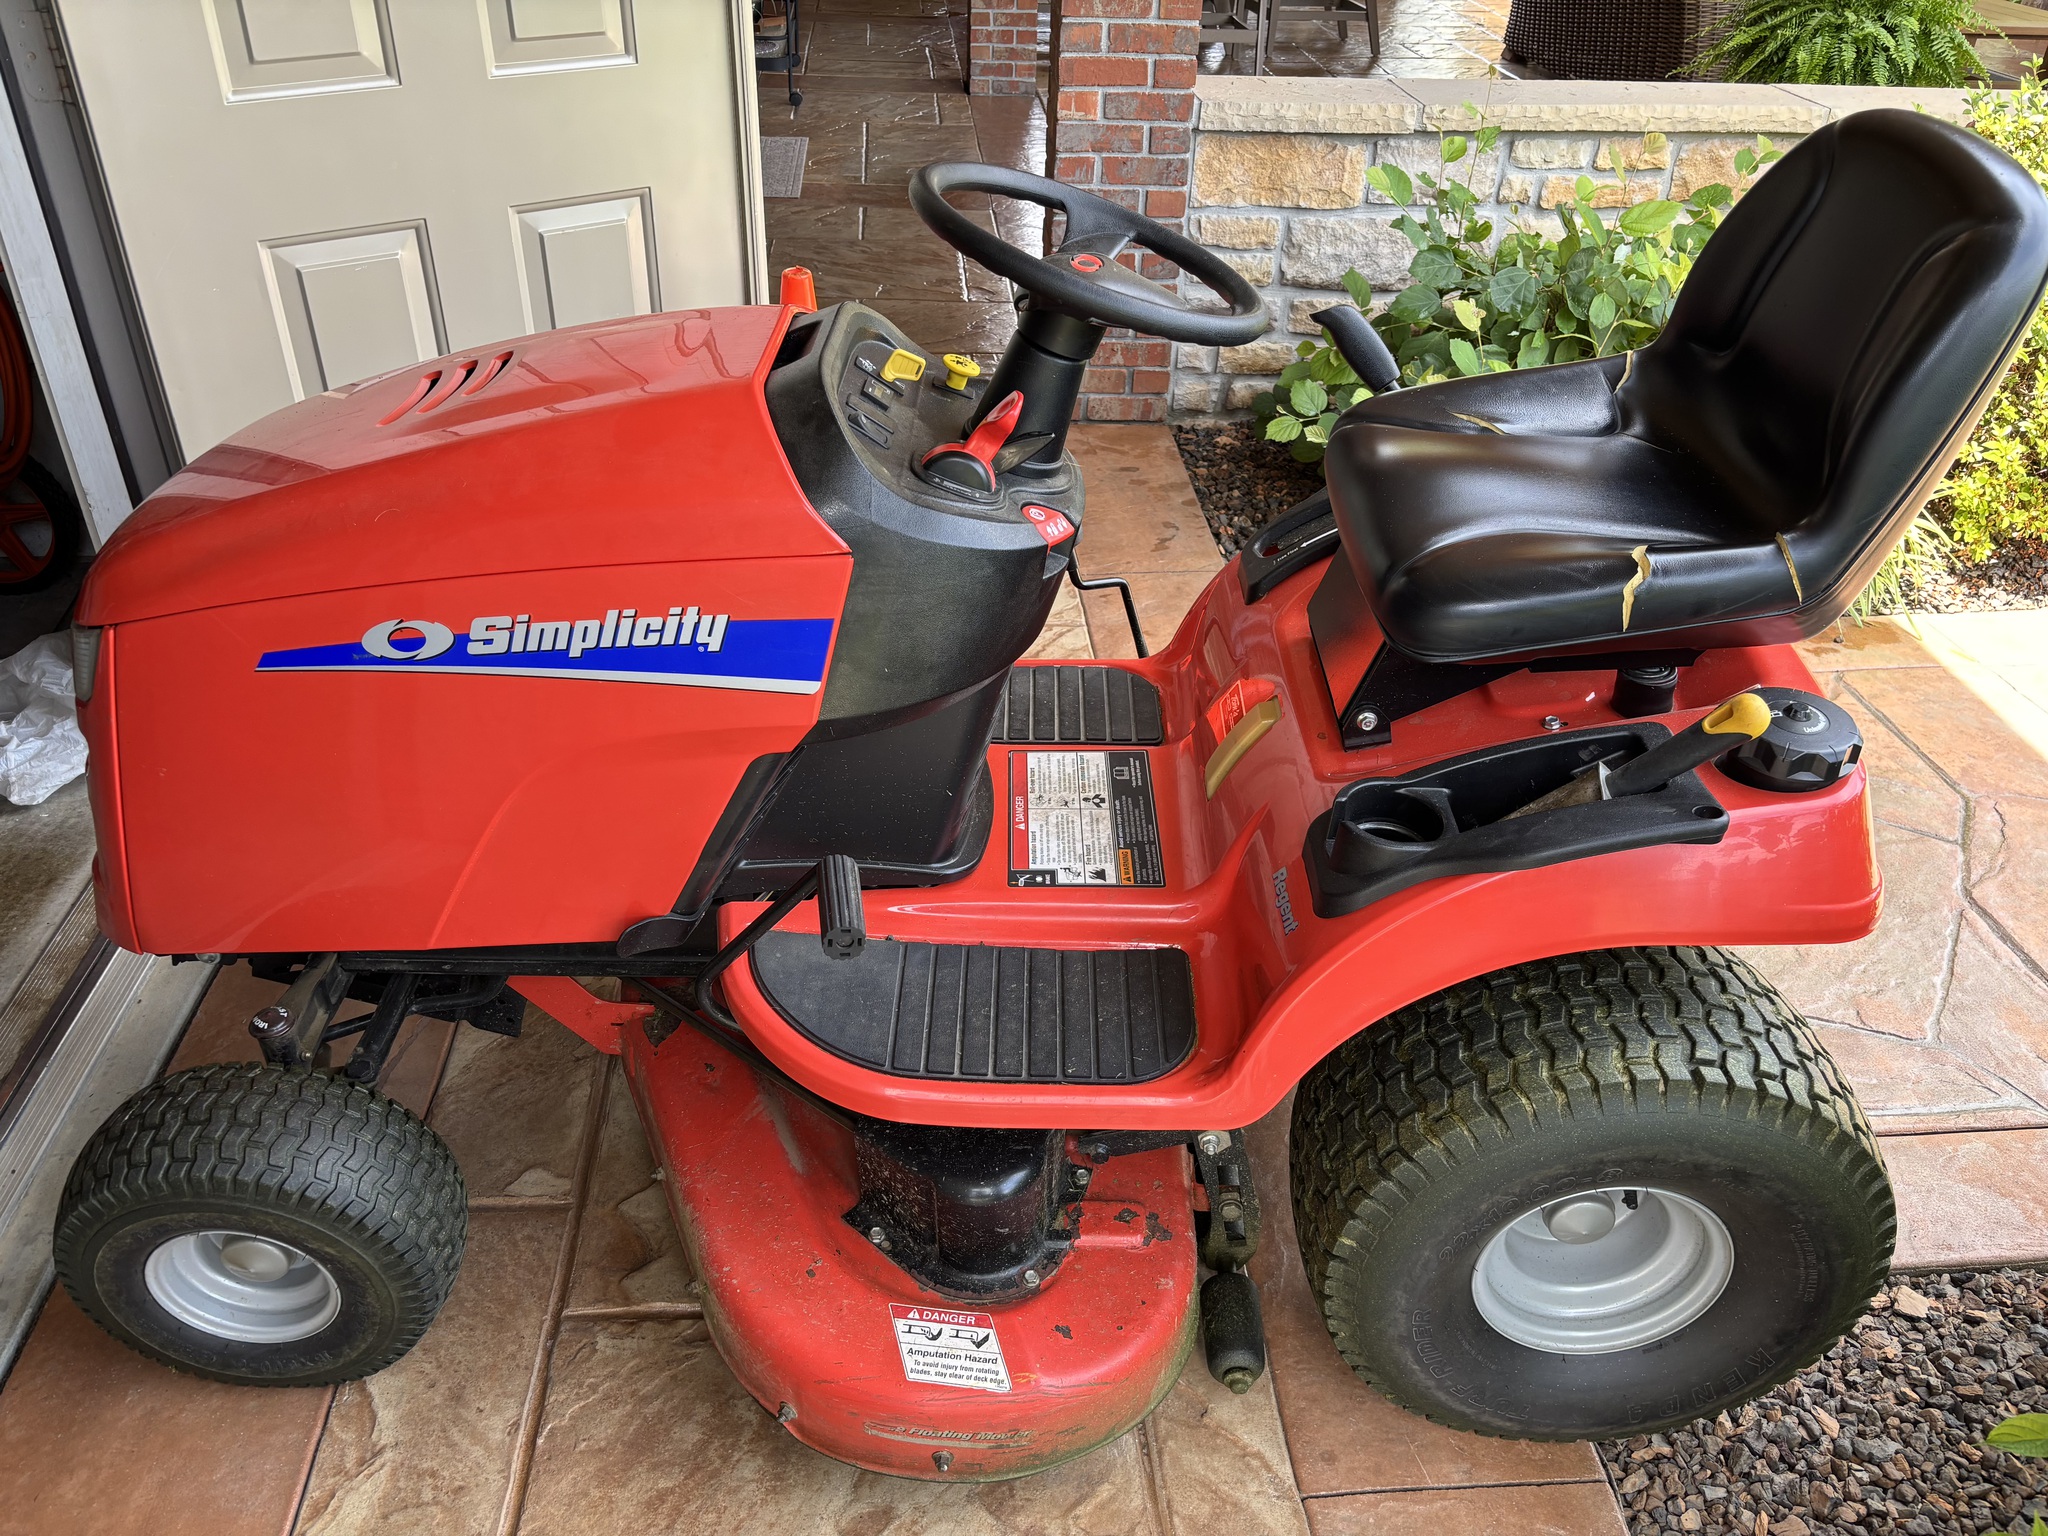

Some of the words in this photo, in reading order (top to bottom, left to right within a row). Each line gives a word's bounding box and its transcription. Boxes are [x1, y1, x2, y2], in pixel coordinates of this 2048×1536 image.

[467, 606, 730, 658] Simplicity
[1015, 796, 1024, 822] DANGER
[1122, 851, 1131, 875] WARNING
[1272, 866, 1299, 936] Regent
[922, 1311, 976, 1325] DANGER
[907, 1347, 962, 1361] Amputation
[964, 1353, 998, 1365] Hazard
[910, 1367, 933, 1376] blades,
[948, 1372, 964, 1380] clear
[989, 1378, 1007, 1386] edge.
[940, 1362, 958, 1371] injury
[975, 1367, 999, 1376] rotating
[1626, 1347, 1776, 1424] KENDA
[909, 1427, 975, 1441] Floating
